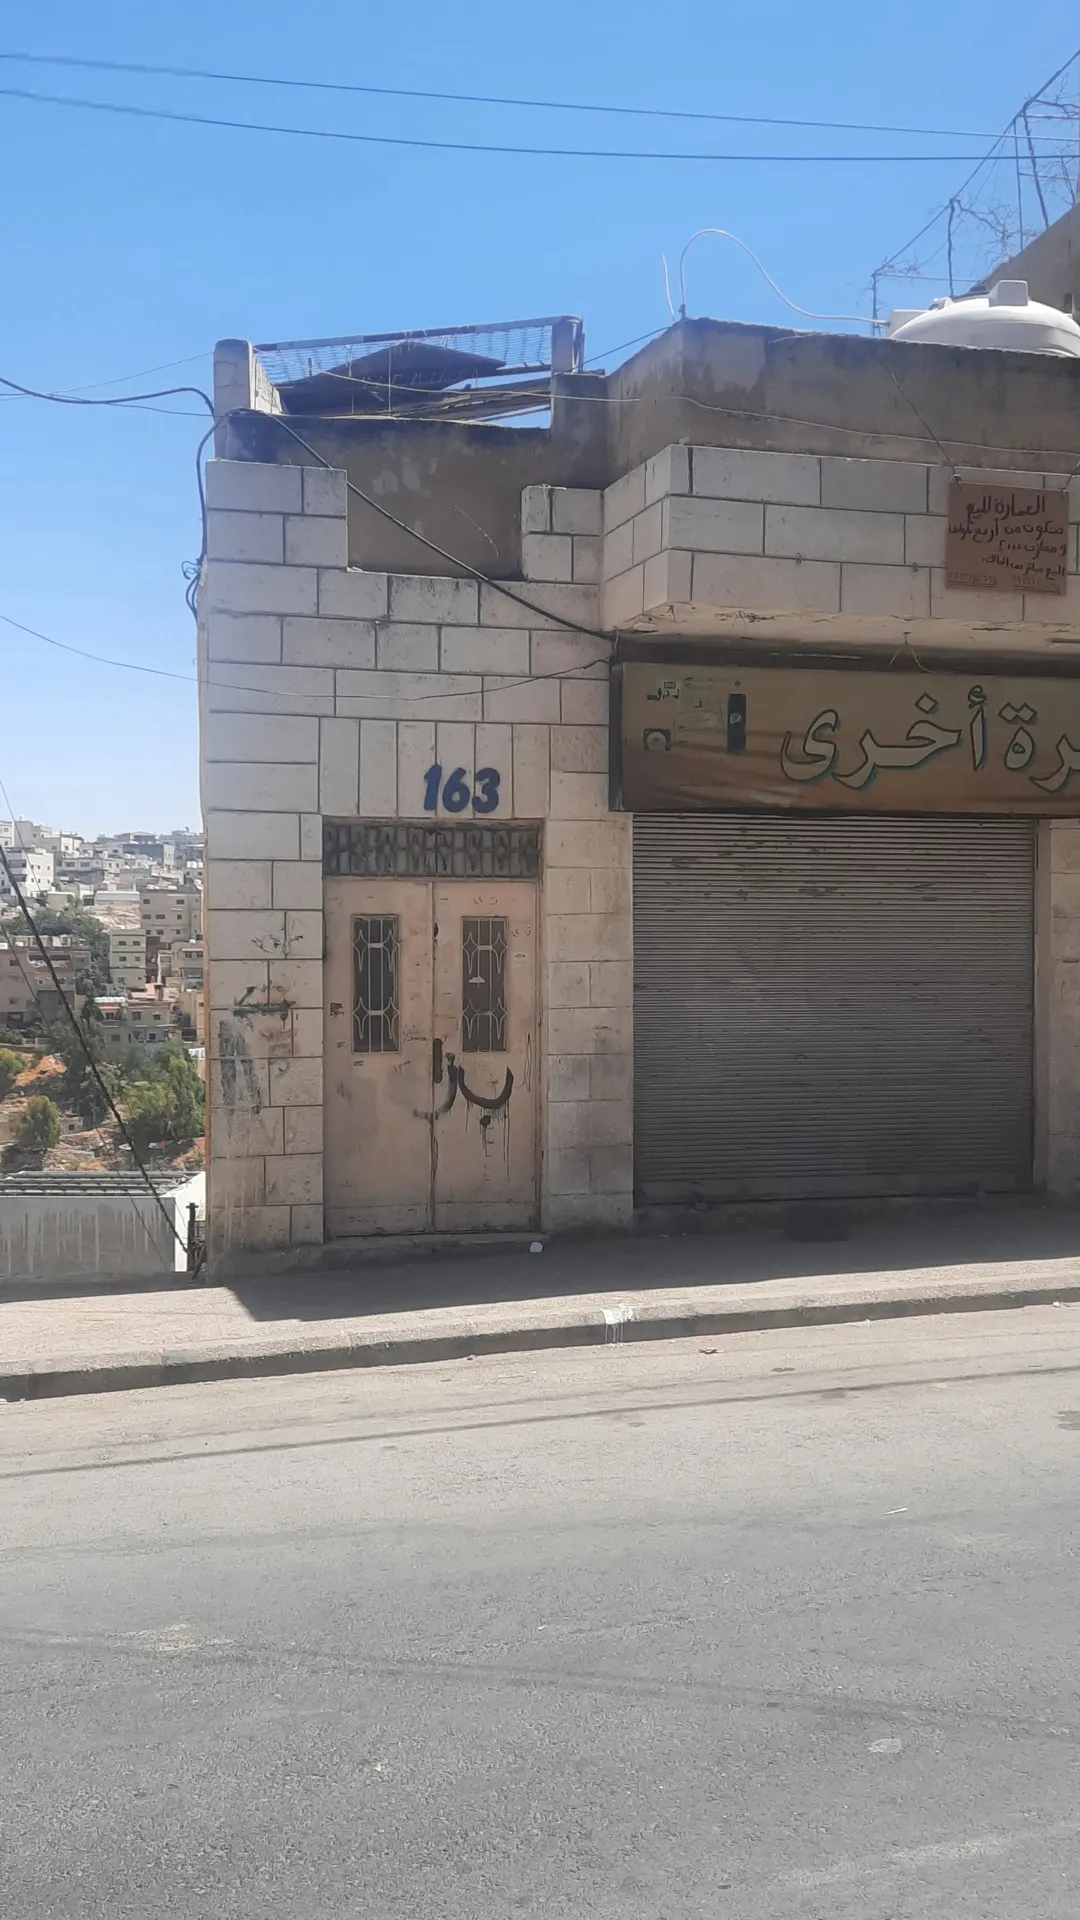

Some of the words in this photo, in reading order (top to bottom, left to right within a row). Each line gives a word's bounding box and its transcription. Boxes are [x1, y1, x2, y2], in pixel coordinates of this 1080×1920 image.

[965, 495, 992, 525] للبيع
[995, 493, 1046, 520] العمارة
[972, 519, 999, 543] أربع
[1004, 525, 1021, 535] من
[1044, 565, 1066, 580] البيع
[780, 684, 988, 790] أخرى
[423, 764, 501, 813] 163
